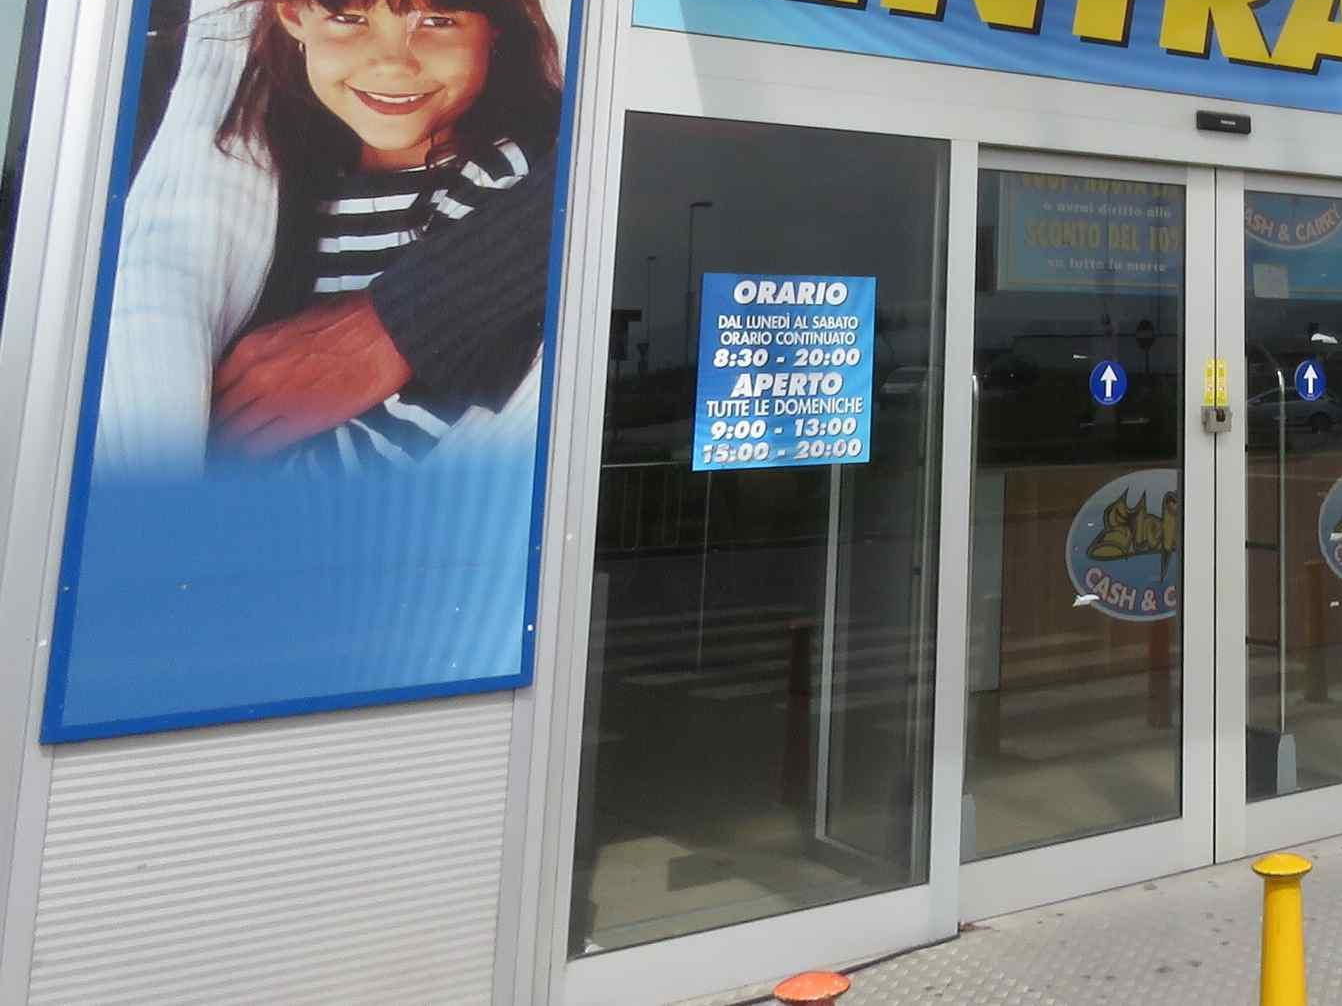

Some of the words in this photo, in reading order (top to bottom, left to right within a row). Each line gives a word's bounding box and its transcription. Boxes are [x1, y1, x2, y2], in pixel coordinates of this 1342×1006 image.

[734, 281, 848, 305] ORARIO
[718, 315, 742, 330] DAL
[746, 312, 790, 330] LUNEDÌ
[794, 315, 808, 330] AL
[812, 315, 858, 330] SABATO
[720, 331, 772, 345] ORARIO
[776, 331, 856, 345] CONTINUATO
[713, 348, 768, 368] 8:30
[793, 348, 861, 367] 20:00
[730, 372, 843, 398] APERTO
[706, 398, 750, 418] TUTTE
[754, 399, 770, 416] LE
[774, 397, 864, 416] DOMENICHE
[710, 419, 767, 440] 9:00
[794, 417, 858, 438] 13:00
[703, 442, 770, 464] 15:00
[793, 438, 862, 460] 20:00
[1086, 568, 1137, 611] CASH
[1141, 589, 1158, 611] &
